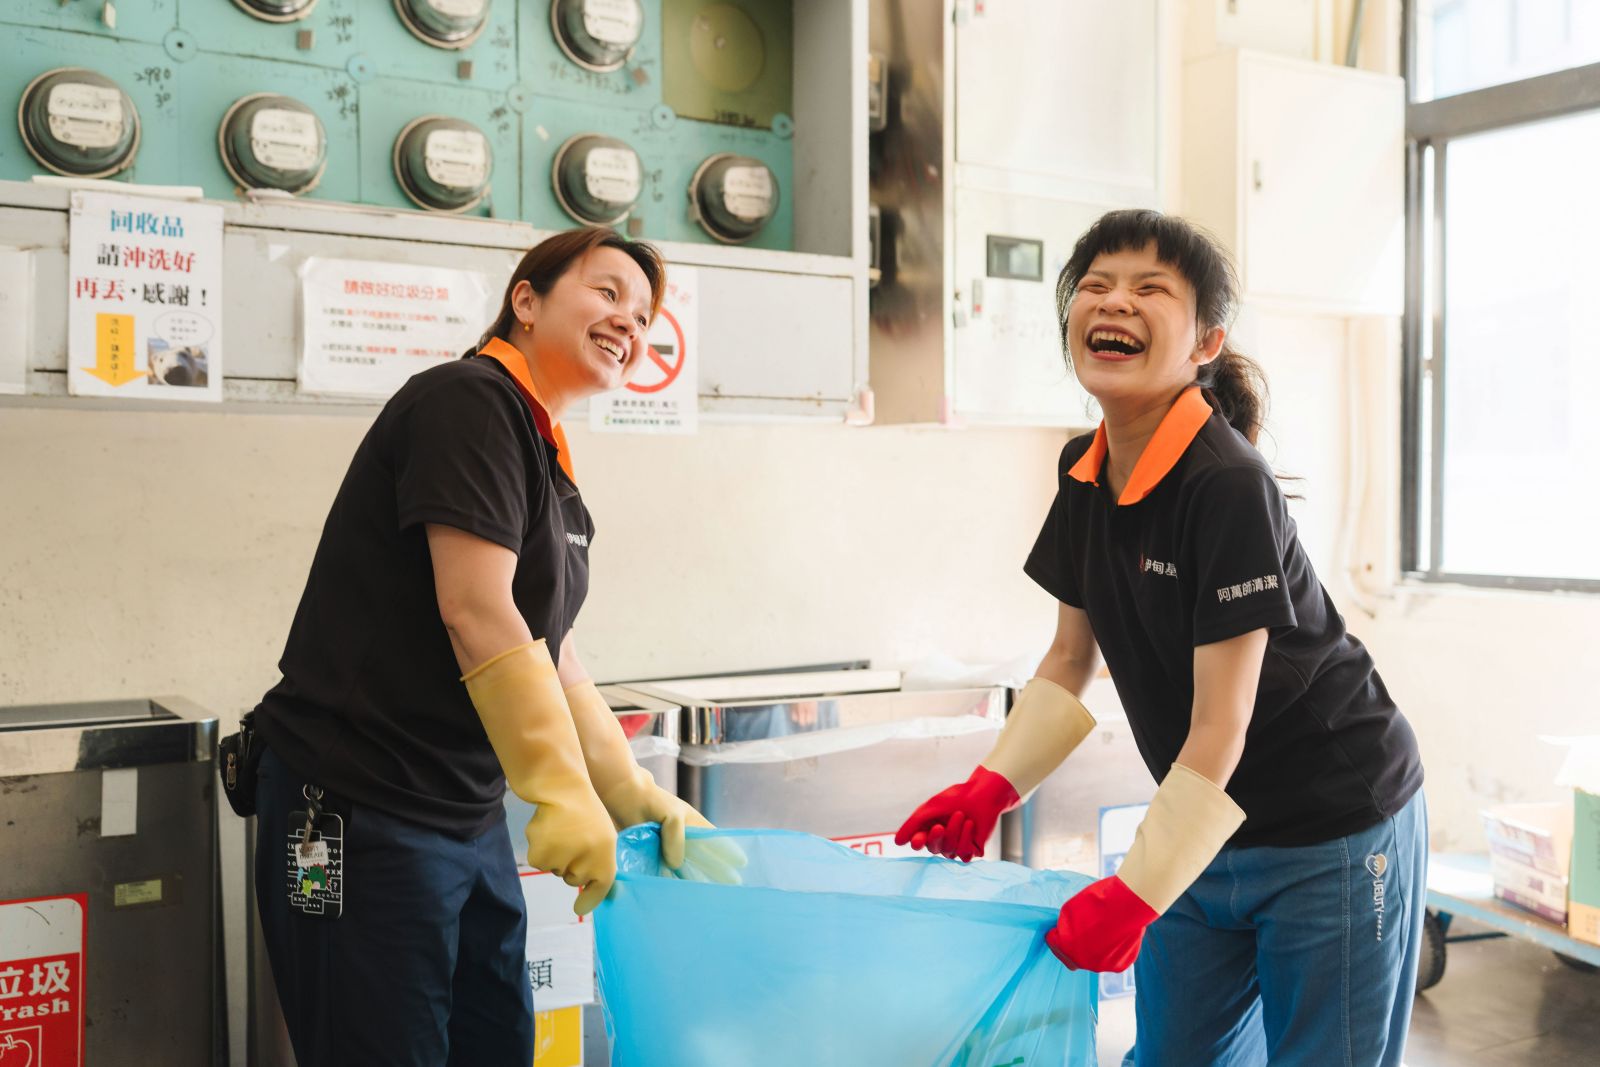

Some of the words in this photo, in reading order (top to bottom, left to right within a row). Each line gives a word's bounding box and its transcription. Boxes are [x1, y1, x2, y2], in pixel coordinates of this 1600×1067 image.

[111, 209, 184, 238] 回收品
[97, 243, 197, 273] 請沖洗好
[1217, 574, 1279, 603] 阿萬師清潔
[0, 998, 70, 1021] rash
